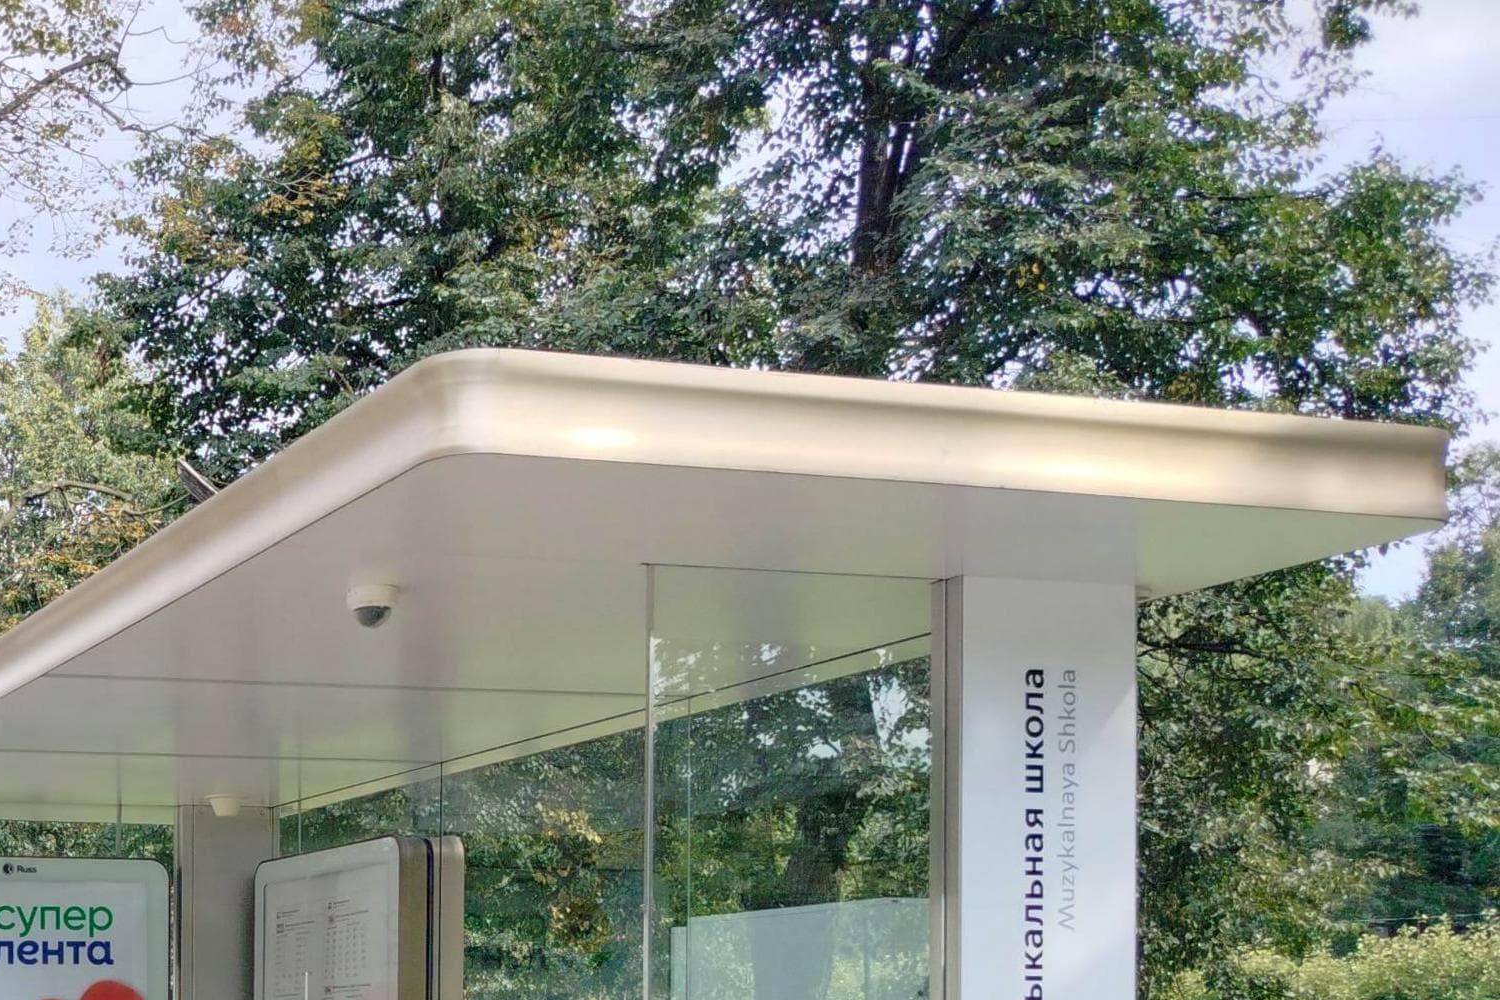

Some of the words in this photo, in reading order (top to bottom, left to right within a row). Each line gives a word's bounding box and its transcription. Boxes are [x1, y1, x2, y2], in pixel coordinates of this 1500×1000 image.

[1025, 668, 1045, 793] школа
[1057, 669, 1077, 754] Shkola
[16, 864, 37, 873] Russ
[1057, 763, 1079, 931] Muzykalnaya
